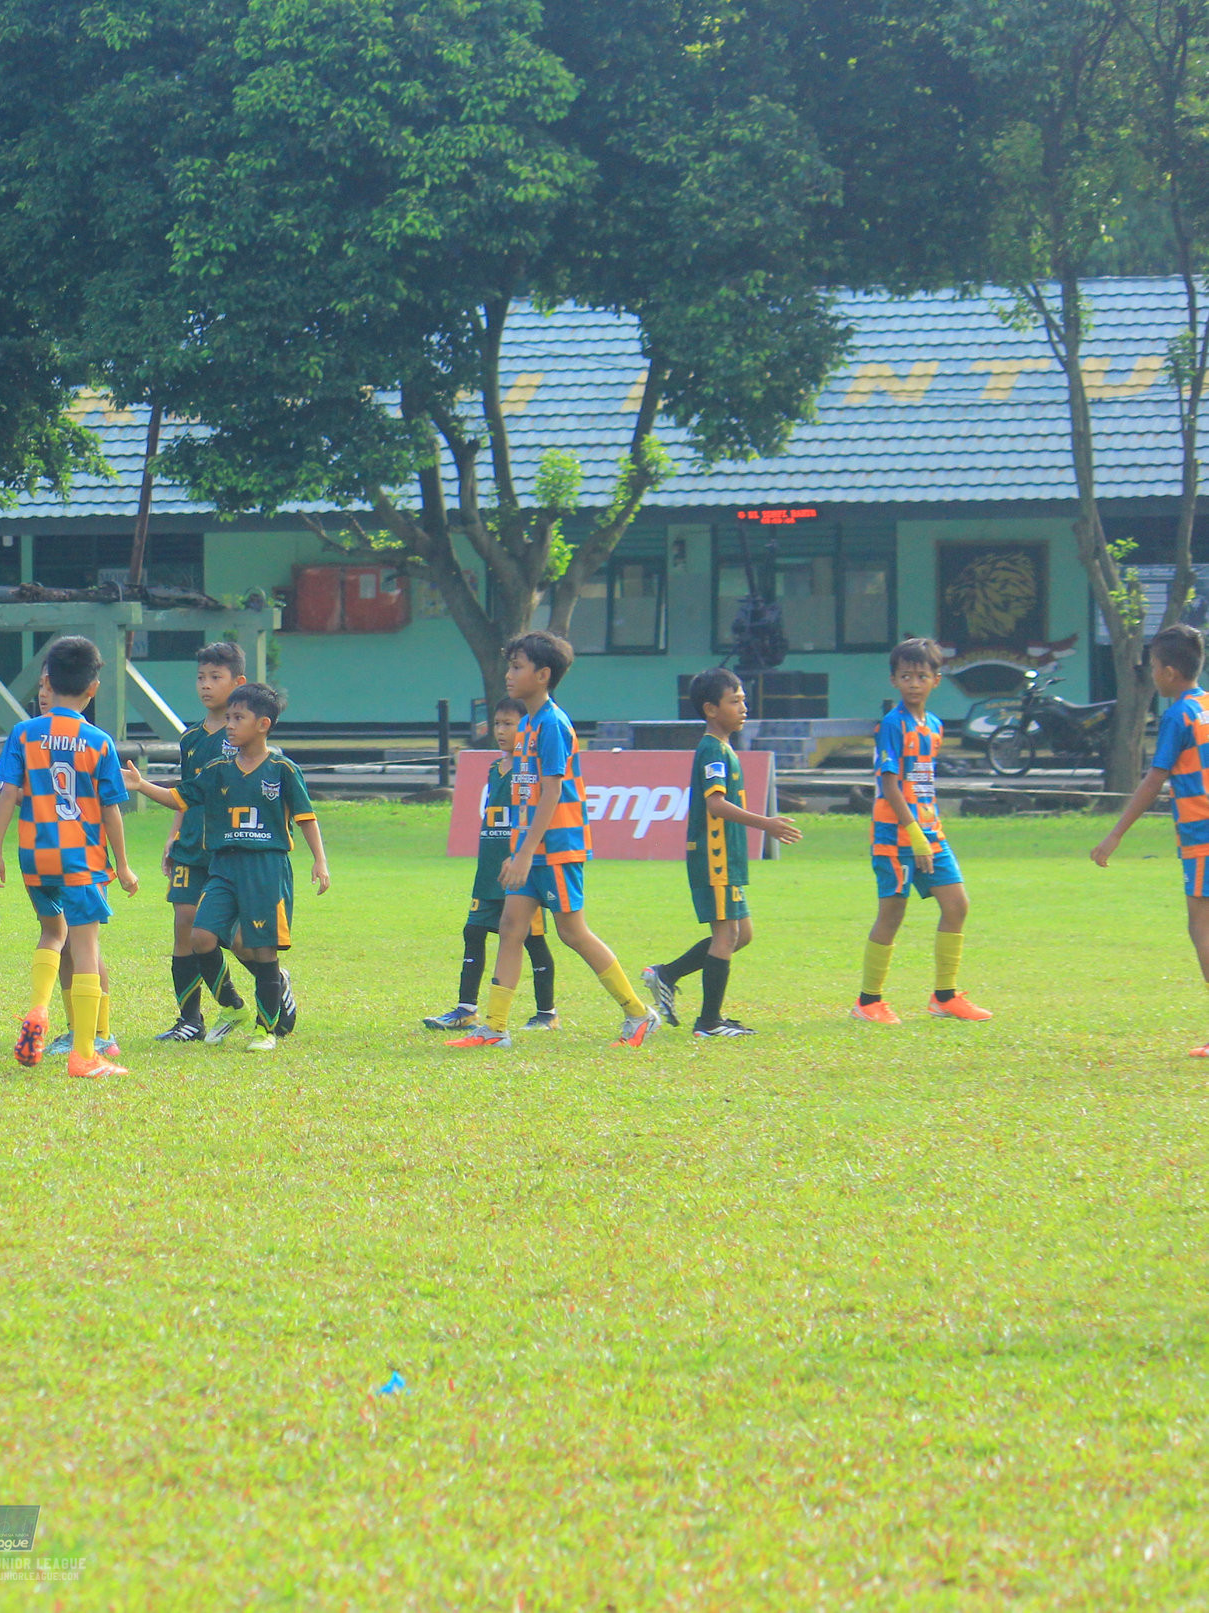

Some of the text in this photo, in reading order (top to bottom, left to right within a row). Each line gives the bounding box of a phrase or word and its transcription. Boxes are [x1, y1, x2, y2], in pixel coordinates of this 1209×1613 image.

[50, 761, 82, 821] 9
[233, 831, 272, 839] OETOMOS
[173, 865, 190, 888] 21
